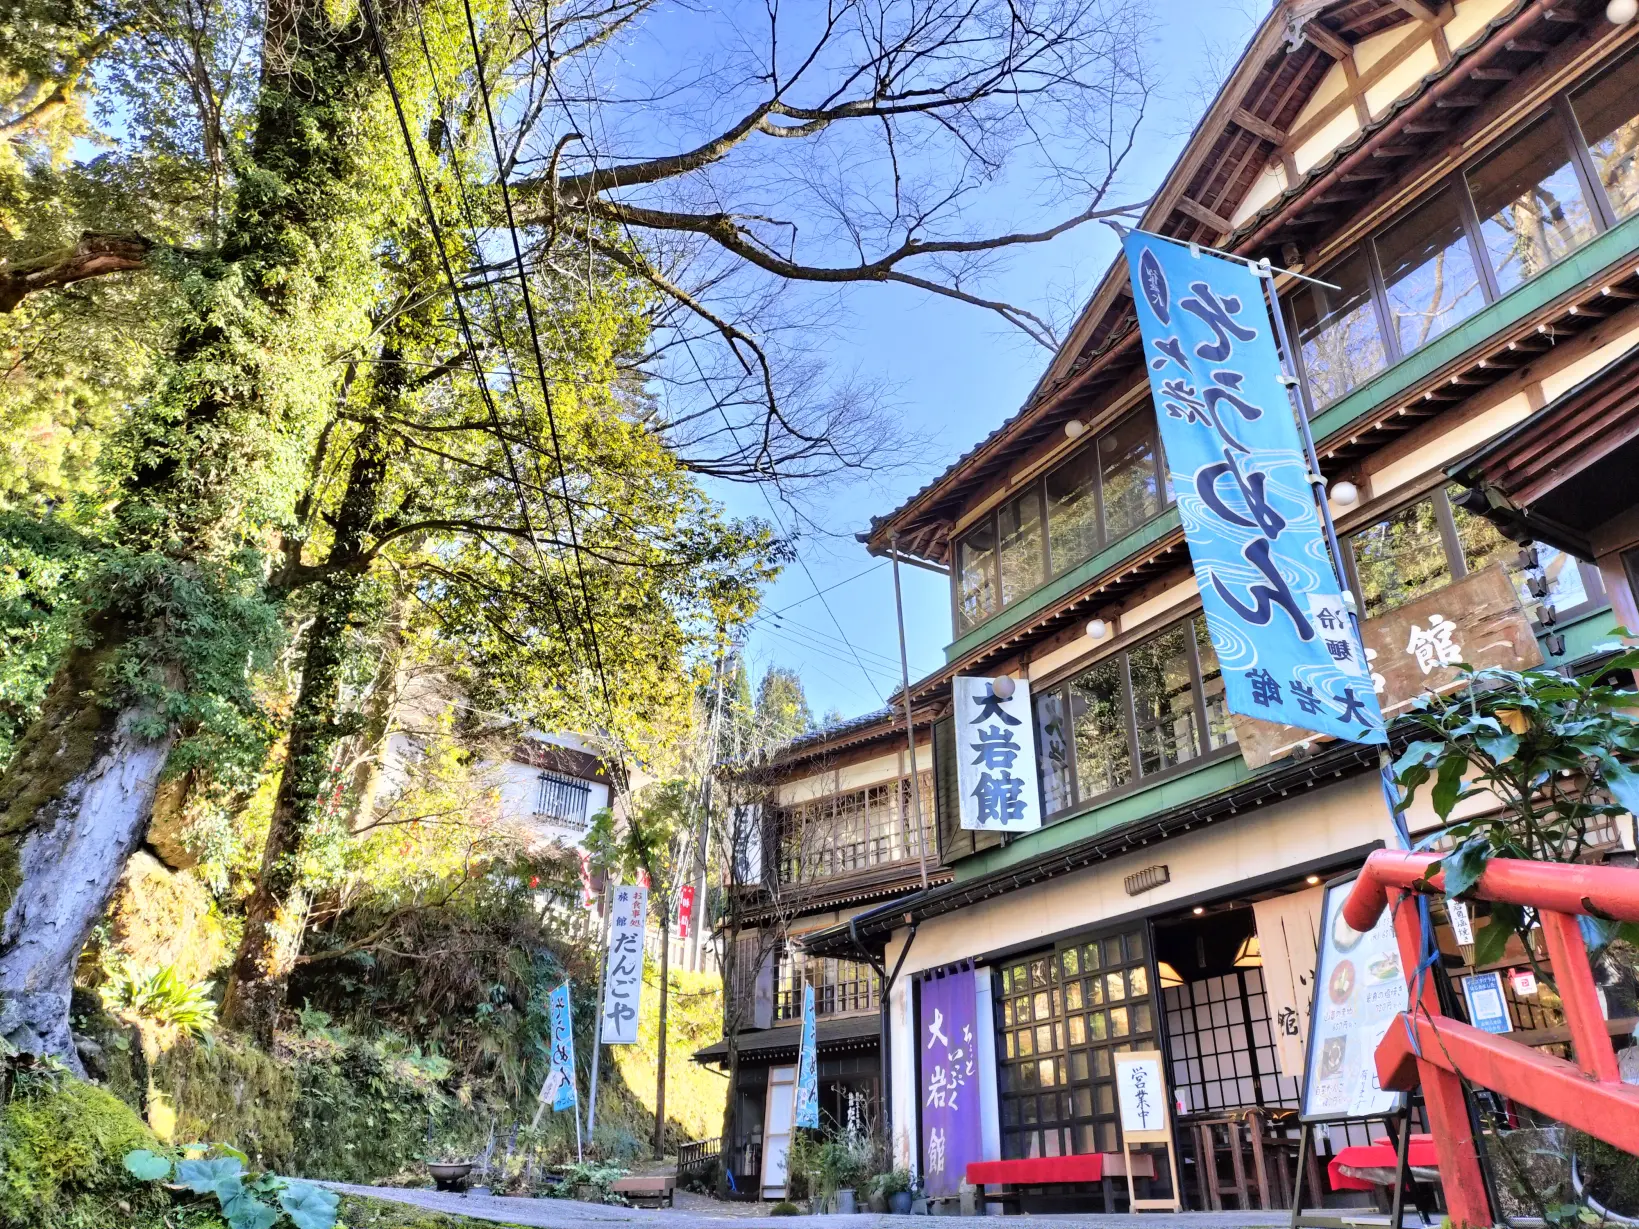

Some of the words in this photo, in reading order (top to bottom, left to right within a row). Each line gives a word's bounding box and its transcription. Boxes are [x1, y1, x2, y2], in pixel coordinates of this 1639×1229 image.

[969, 681, 1028, 825] 大岩館
[616, 892, 628, 927] 旅館
[629, 892, 643, 928] お食事処
[607, 932, 638, 1036] だんごや
[926, 1008, 948, 1177] 大岩館
[946, 1049, 965, 1111] いっぷく
[1131, 1067, 1151, 1129] 営業中
